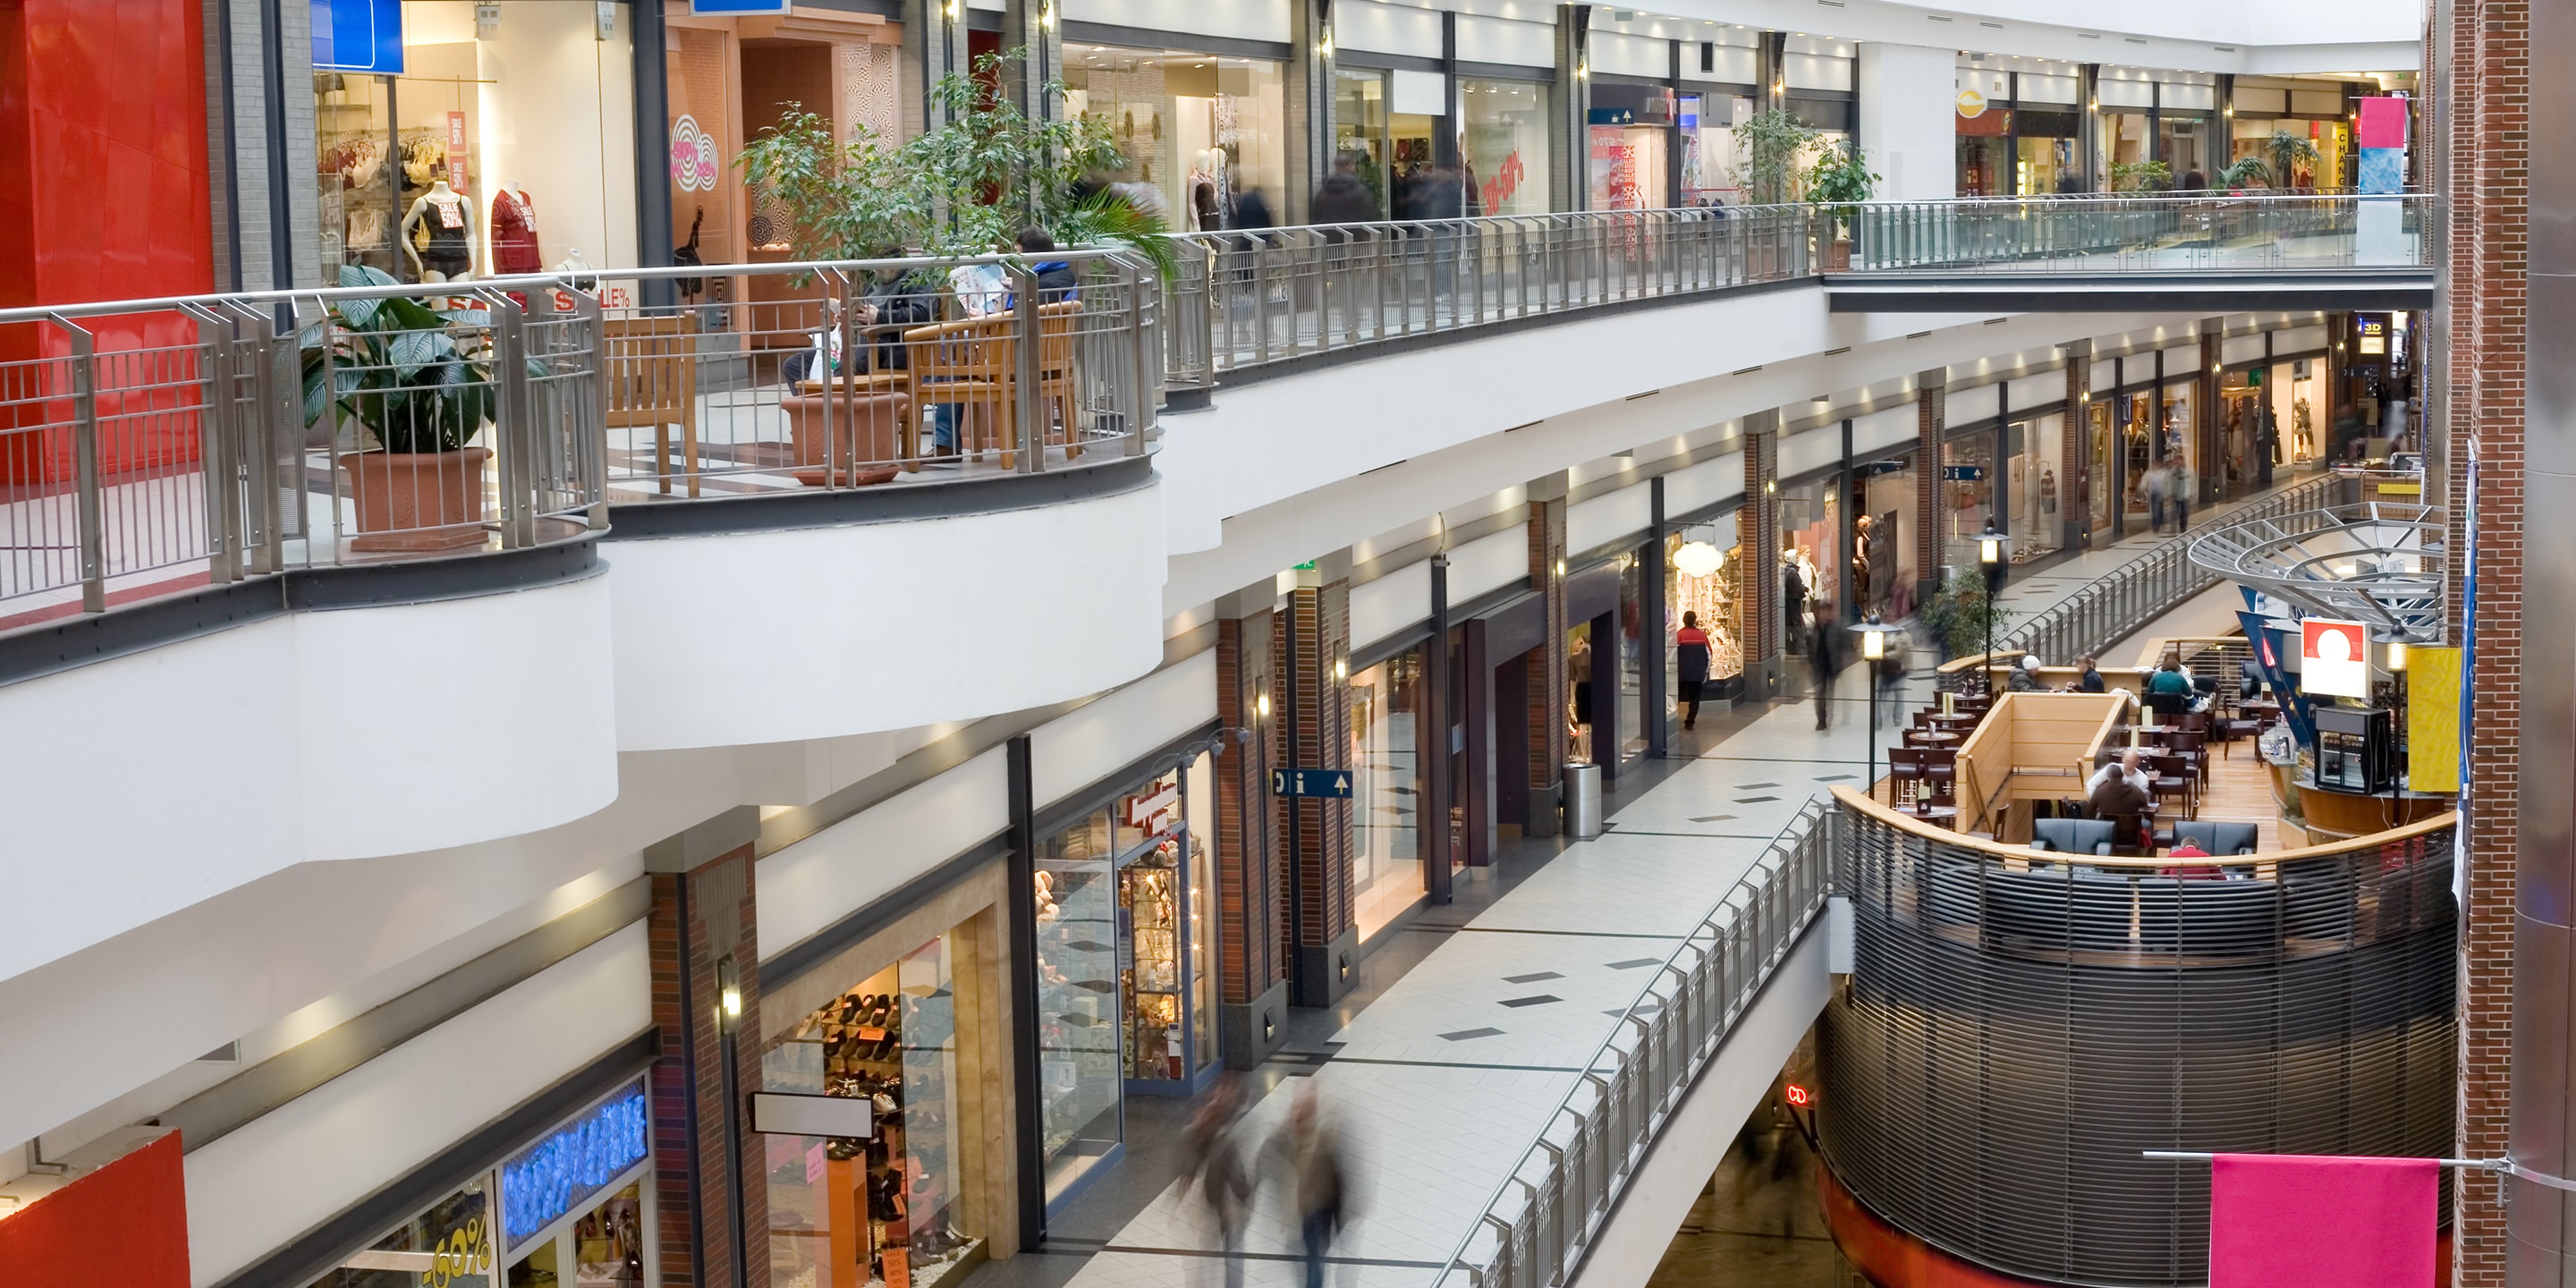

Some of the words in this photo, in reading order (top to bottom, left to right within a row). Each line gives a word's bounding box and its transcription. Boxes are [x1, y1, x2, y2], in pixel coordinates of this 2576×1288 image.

[2338, 133, 2346, 194] CHANGE
[439, 203, 459, 213] SALE
[520, 206, 534, 216] SALE
[442, 212, 463, 228] 50%
[555, 288, 630, 310] SLE%
[2364, 323, 2381, 332] 3D
[1788, 1085, 1807, 1104] CD
[422, 1213, 491, 1288] -60%
